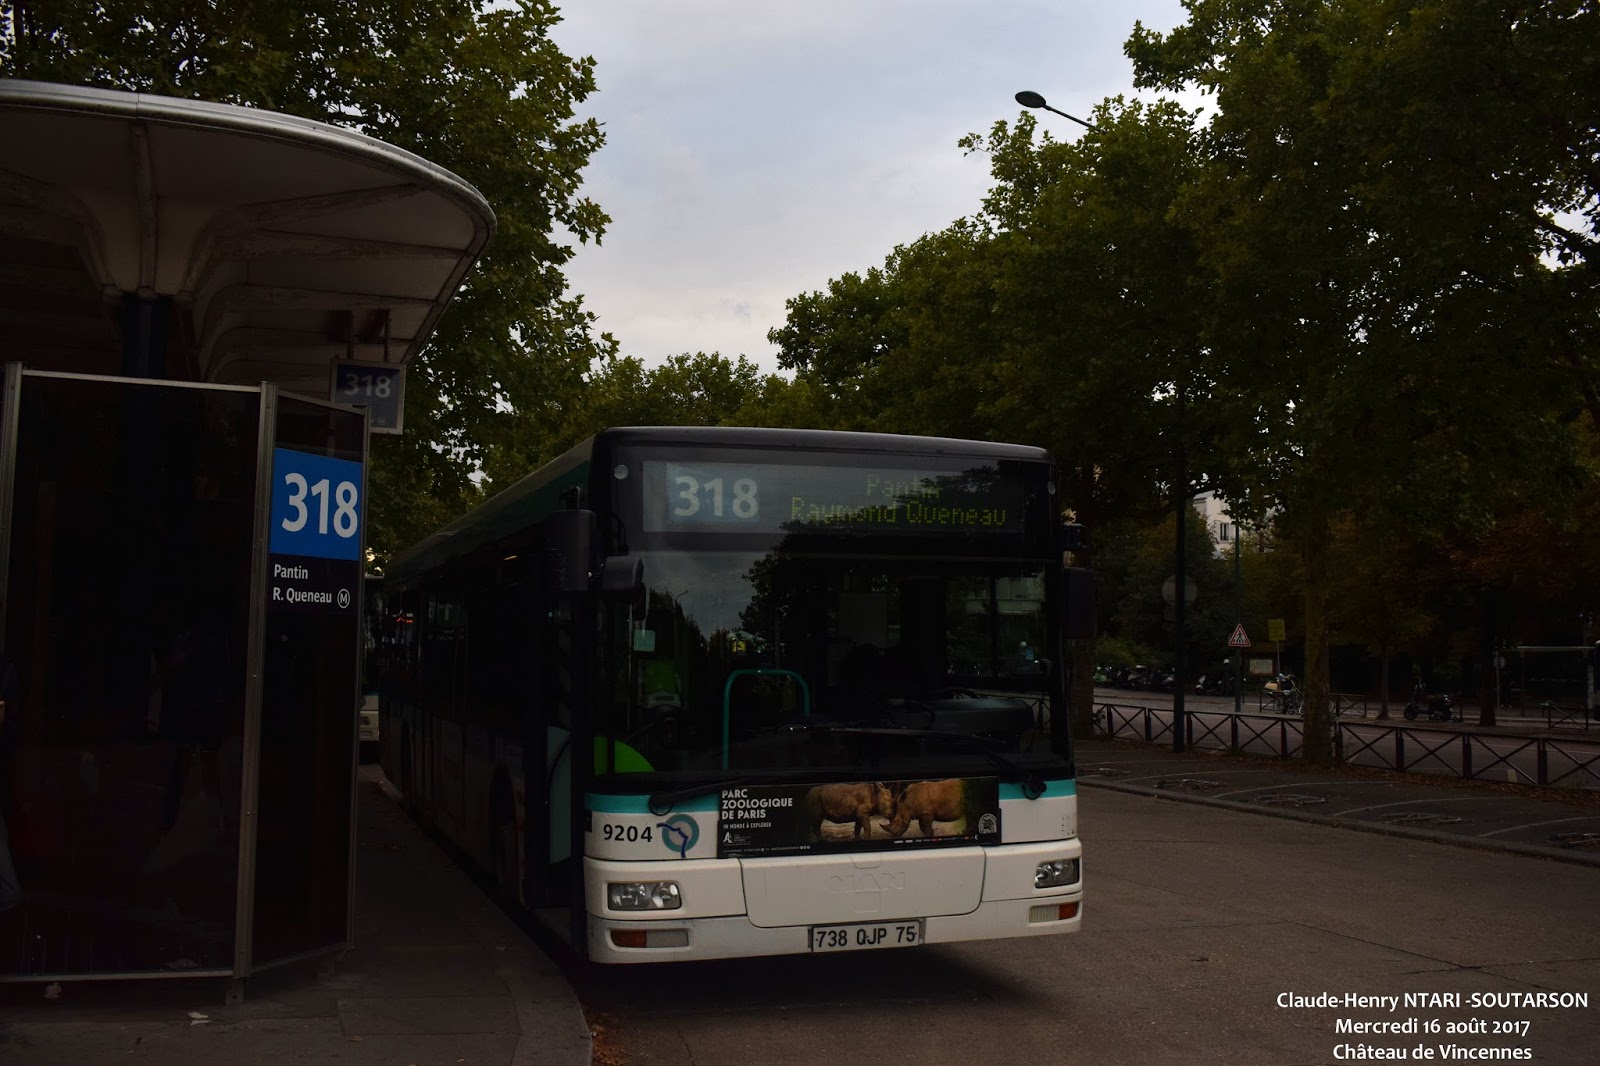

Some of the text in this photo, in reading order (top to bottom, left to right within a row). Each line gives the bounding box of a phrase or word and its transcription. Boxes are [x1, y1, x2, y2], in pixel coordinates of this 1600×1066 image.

[344, 374, 391, 398] 318
[281, 472, 358, 538] 318
[673, 476, 759, 519] 318
[791, 497, 1008, 526] Raymond Queneau
[274, 564, 308, 579] Pantin
[273, 587, 284, 601] R.
[286, 588, 332, 604] Queneau
[722, 789, 748, 798] PARC
[722, 798, 793, 809] ZOOLOGIQUE
[722, 809, 767, 820] DE PARIS
[603, 824, 652, 842] 9204
[817, 926, 915, 947] 738 QJP 75
